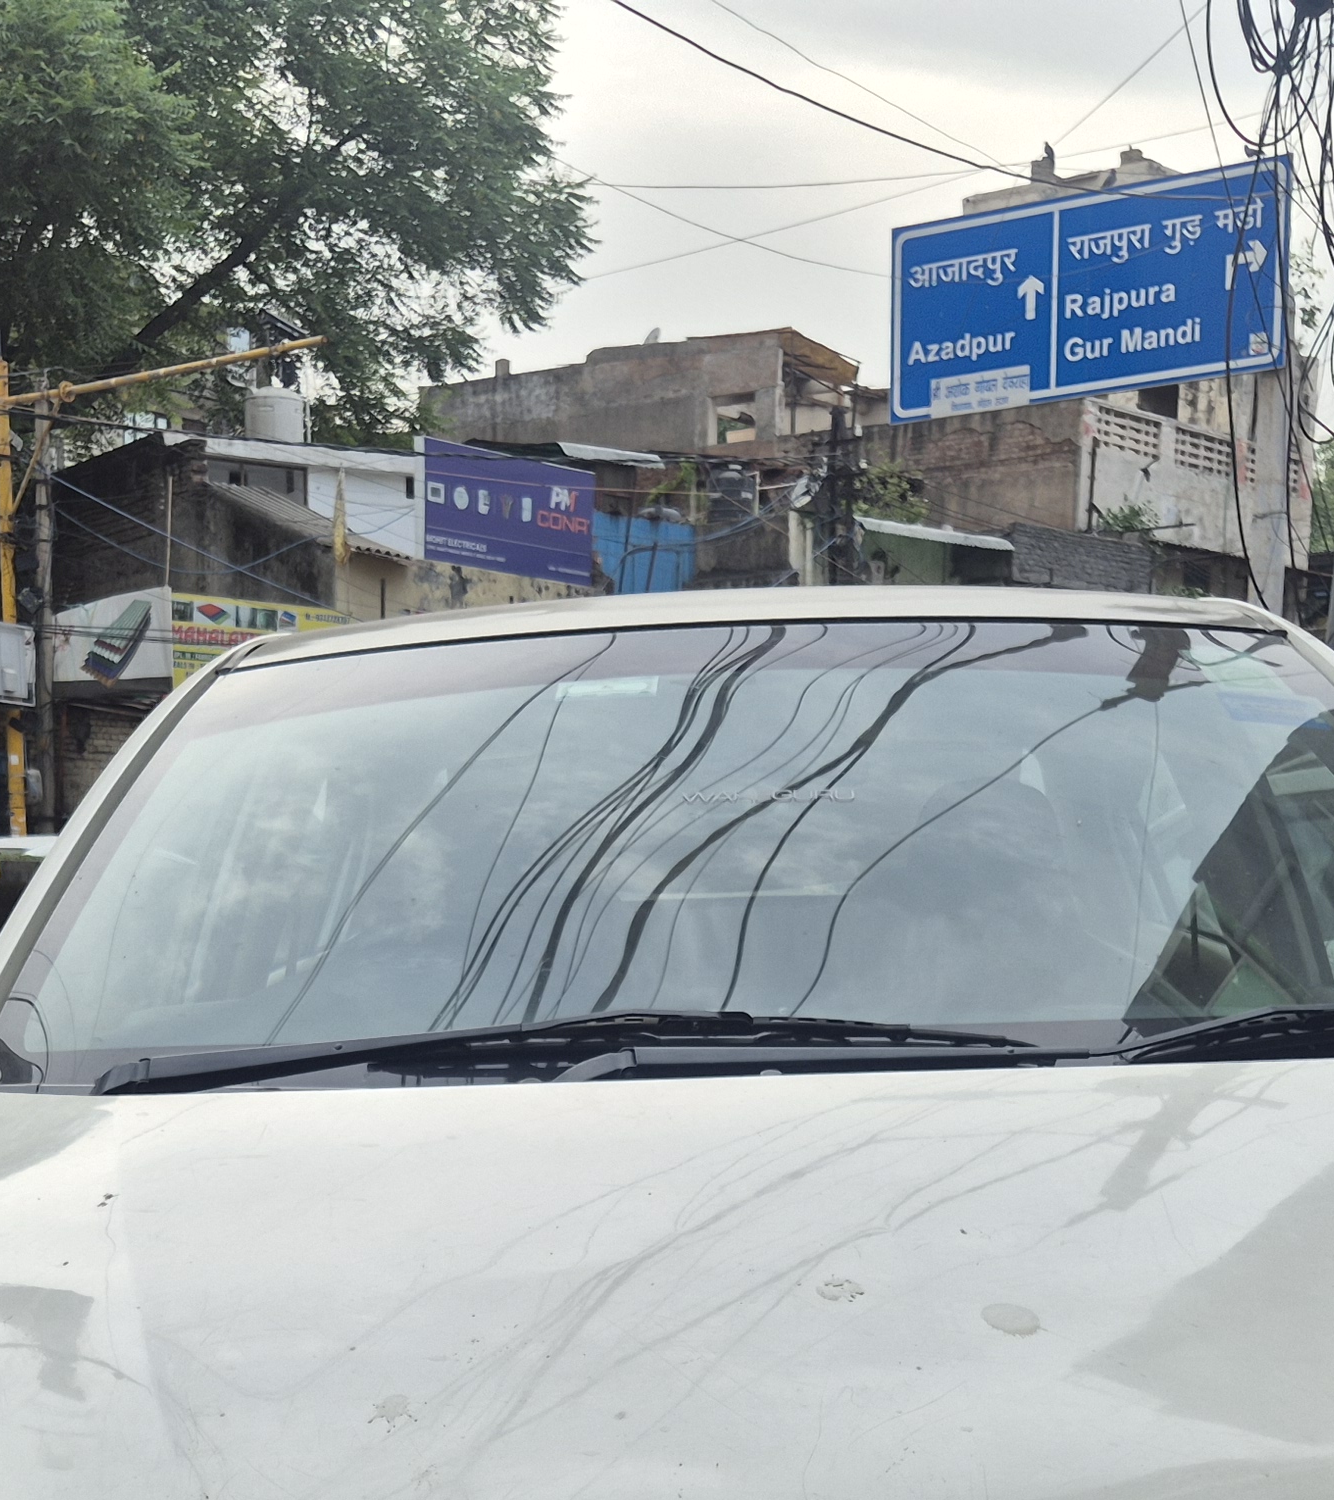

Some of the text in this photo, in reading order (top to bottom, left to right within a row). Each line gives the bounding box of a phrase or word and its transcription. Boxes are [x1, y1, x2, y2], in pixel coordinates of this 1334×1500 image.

[1067, 224, 1152, 264] राजपुरा
[908, 248, 1018, 288] आजादपुर
[1065, 284, 1177, 320] Rajpura
[907, 330, 1016, 367] Azadpur
[1064, 318, 1202, 364] Gur Mandi
